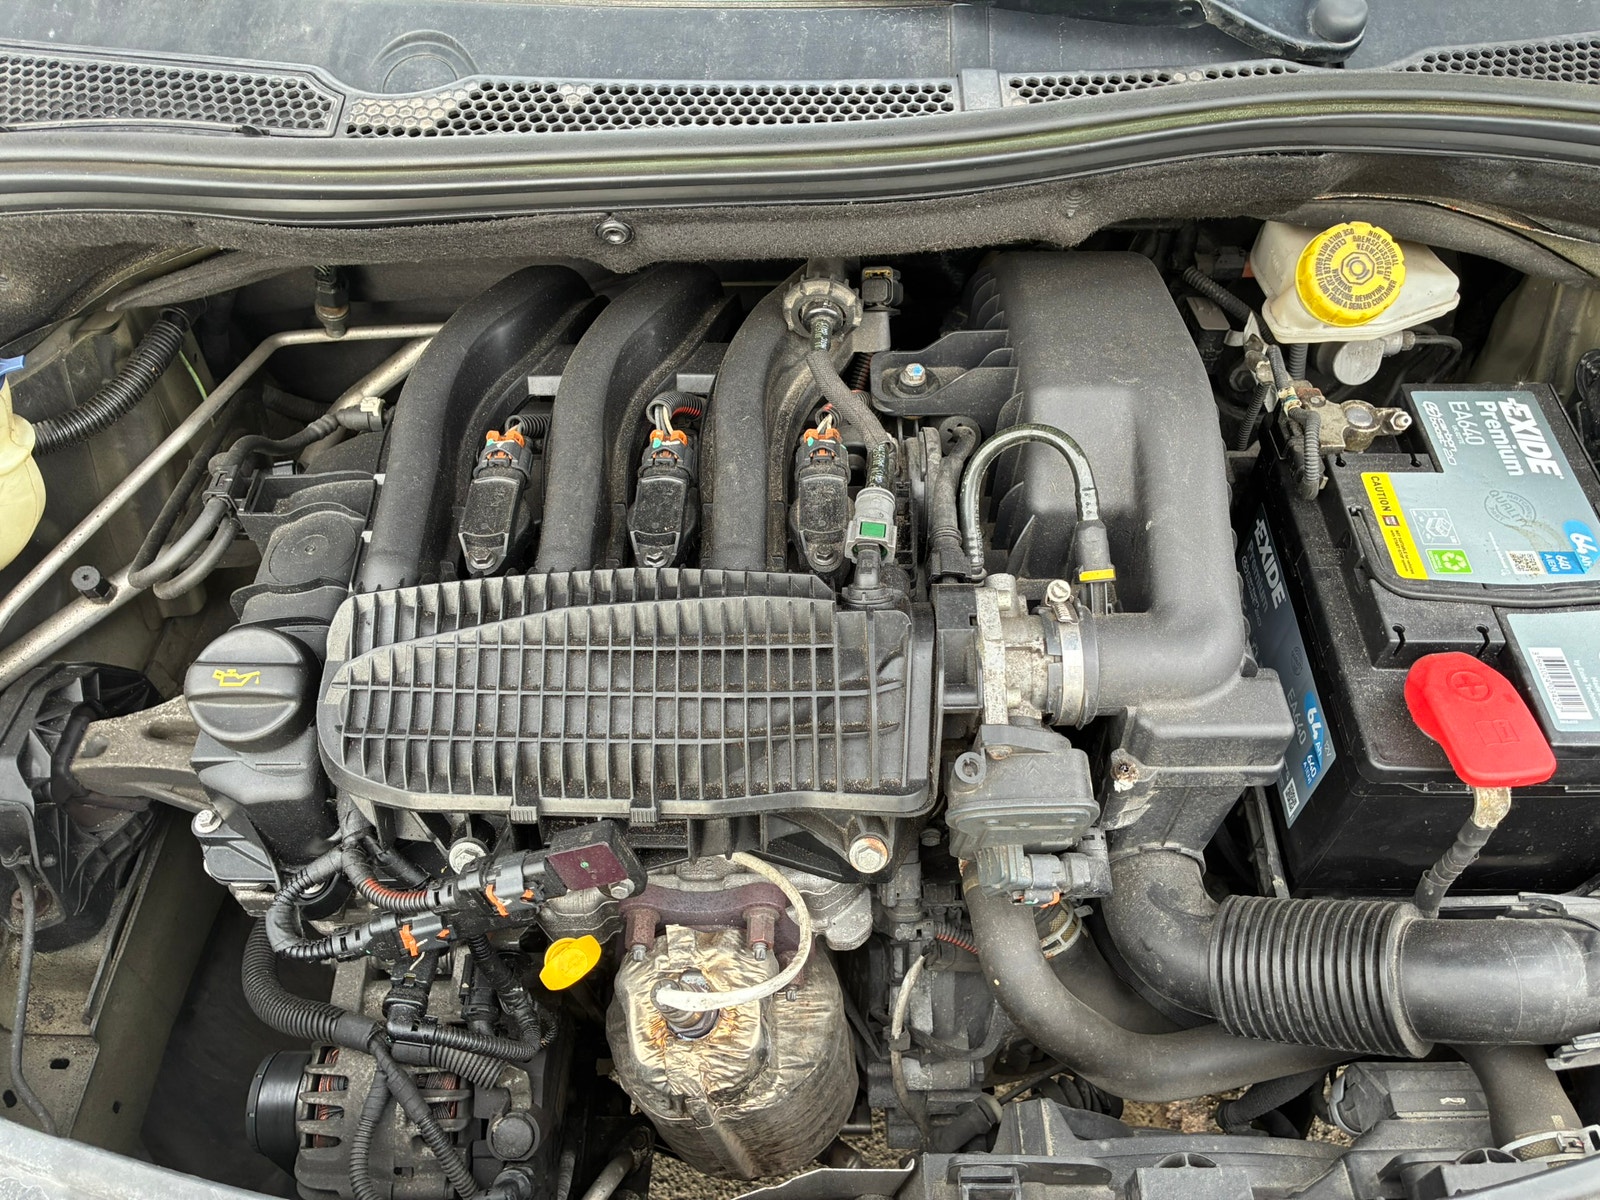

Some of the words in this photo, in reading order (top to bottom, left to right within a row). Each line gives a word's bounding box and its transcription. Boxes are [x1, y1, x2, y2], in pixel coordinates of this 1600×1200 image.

[1329, 238, 1347, 255] CLEAN
[1368, 230, 1382, 241] NUR
[1381, 238, 1399, 267] ORIGINAL
[1317, 277, 1330, 295] FLUID
[1343, 301, 1348, 309] A
[1372, 279, 1397, 306] CONTAINER
[1325, 275, 1336, 286] CAP
[1332, 268, 1353, 293] WARNING
[1355, 284, 1386, 302] REMOVING
[1448, 401, 1486, 445] EA640
[1475, 401, 1525, 476] Premium
[1498, 397, 1564, 477] EXIDE
[1371, 475, 1392, 512] CAUTION
[1570, 532, 1598, 554] 64
[1254, 518, 1286, 610] EXIDE
[1555, 554, 1572, 570] 640
[1287, 687, 1307, 745] EA640
[1308, 707, 1322, 740] 64
[1307, 754, 1317, 778] 640
